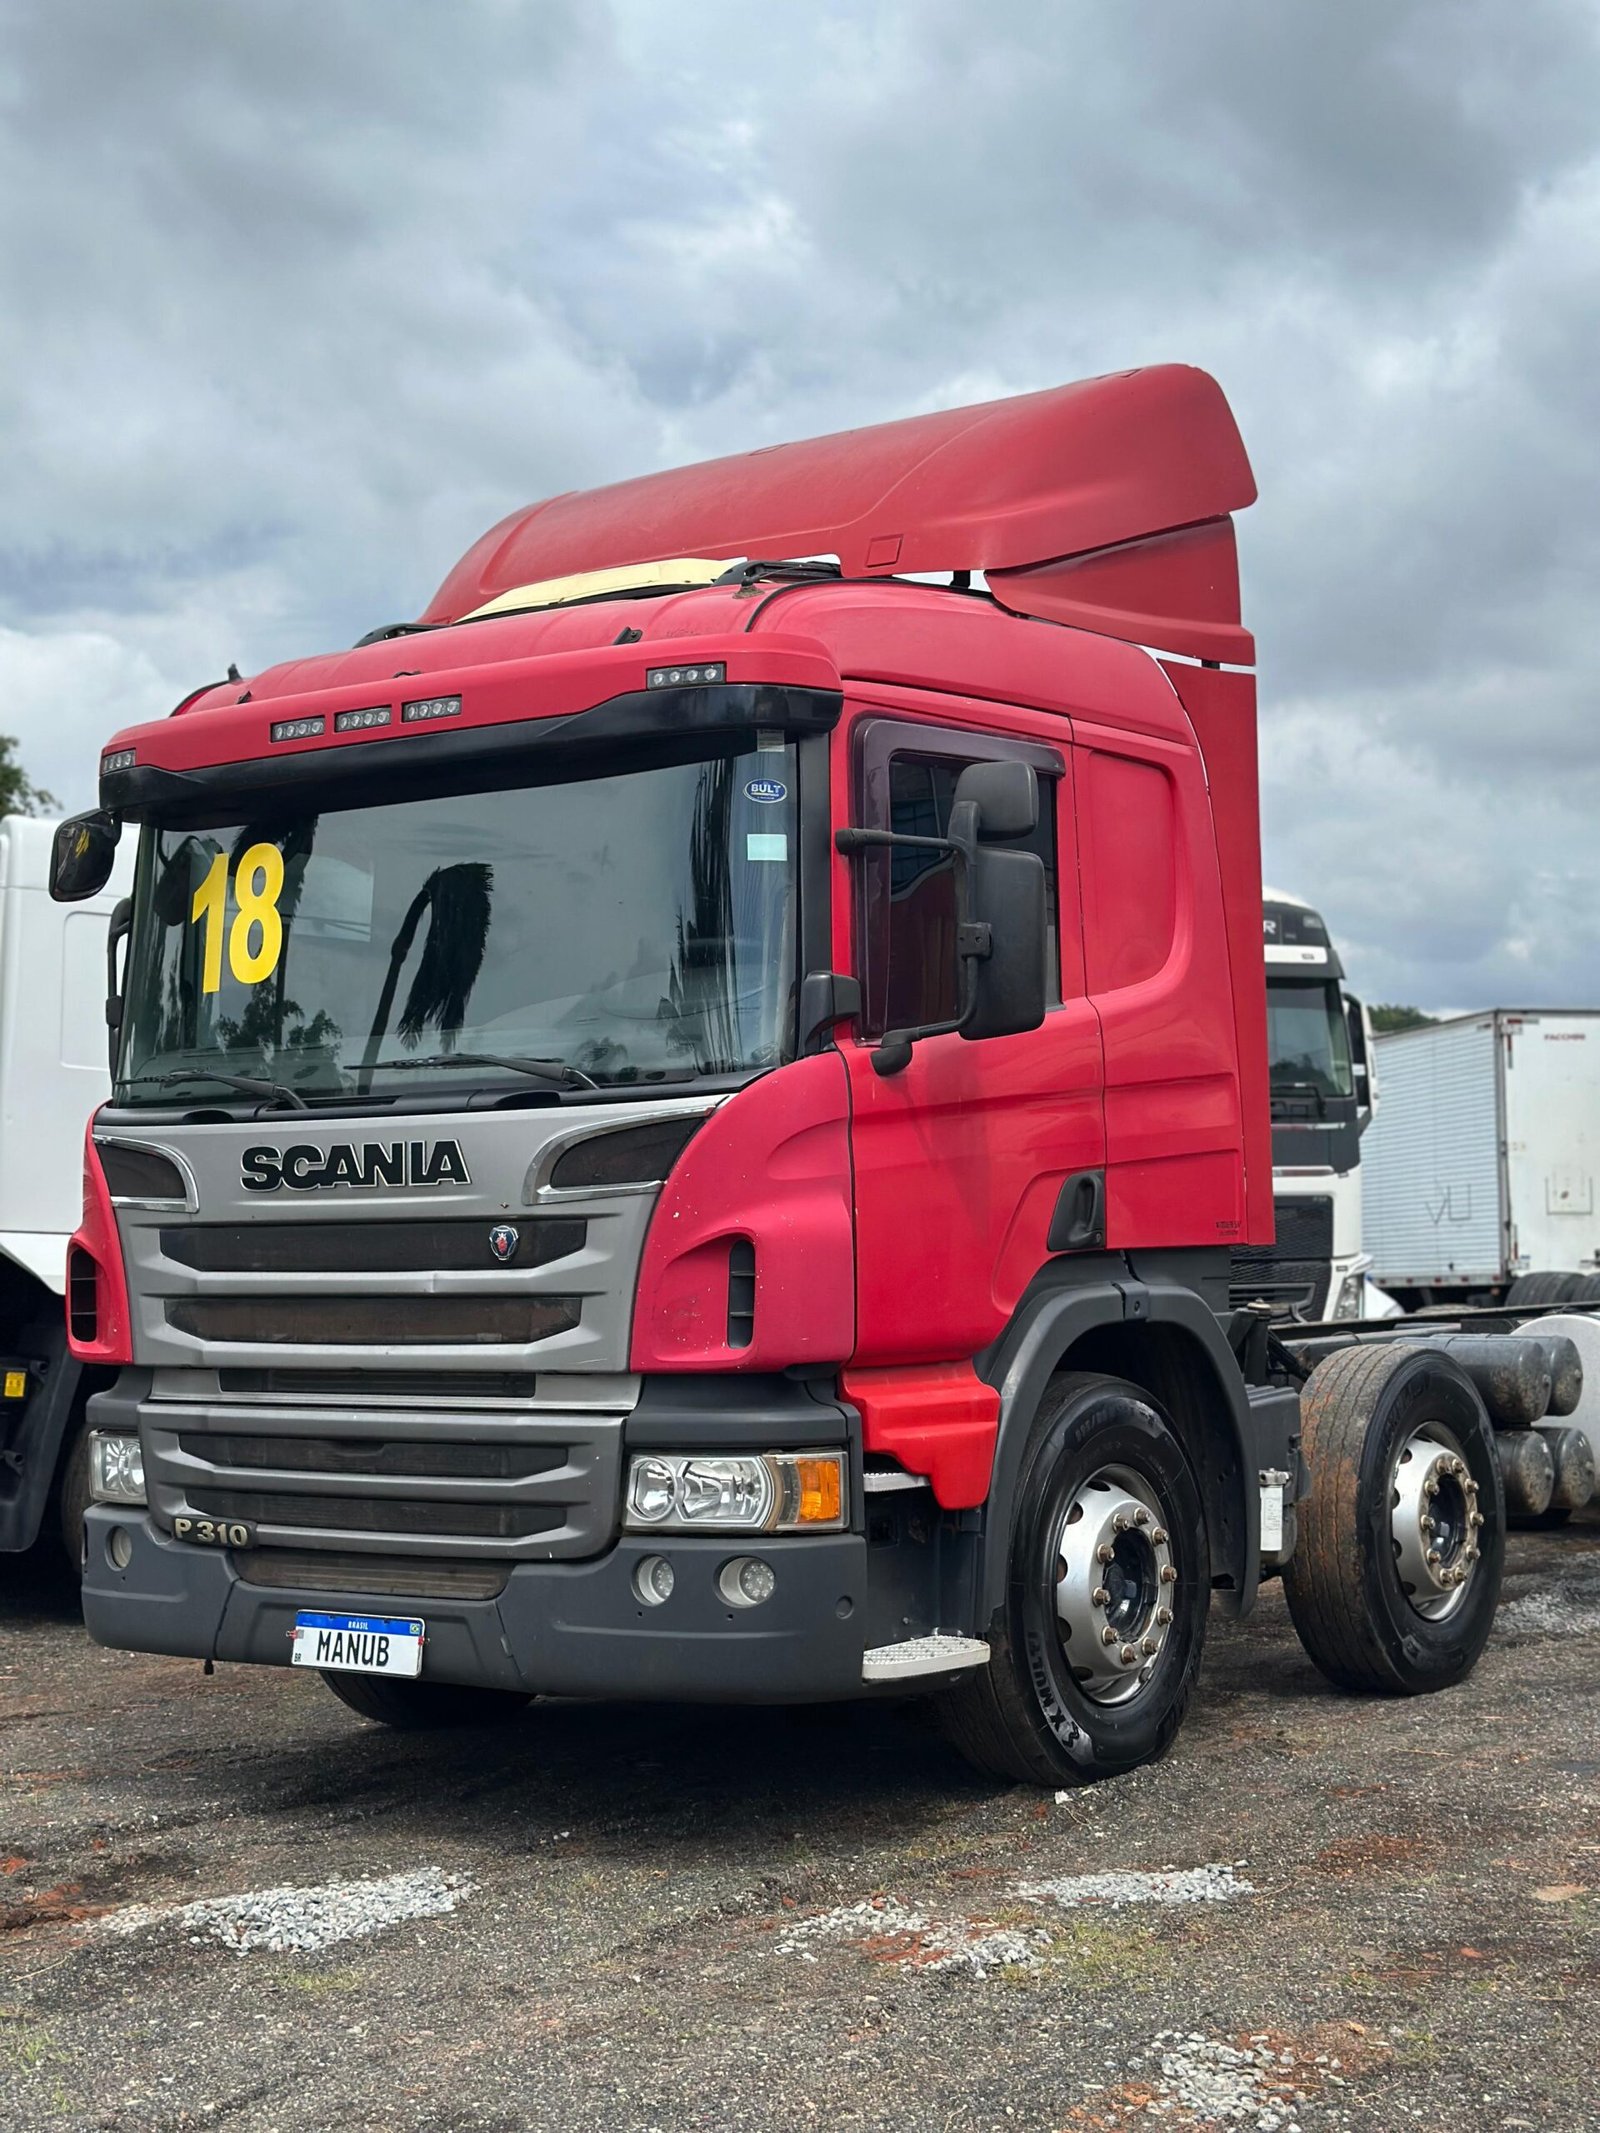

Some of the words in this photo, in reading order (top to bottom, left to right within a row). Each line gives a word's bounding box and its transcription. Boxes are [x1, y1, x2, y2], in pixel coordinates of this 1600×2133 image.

[751, 783, 781, 794] BULT
[192, 842, 285, 994] 18
[240, 1139, 472, 1193] SCANIA
[175, 1518, 192, 1539] P
[196, 1521, 248, 1547] 310
[347, 1620, 369, 1631] BRASIL
[316, 1630, 390, 1668] MANUB
